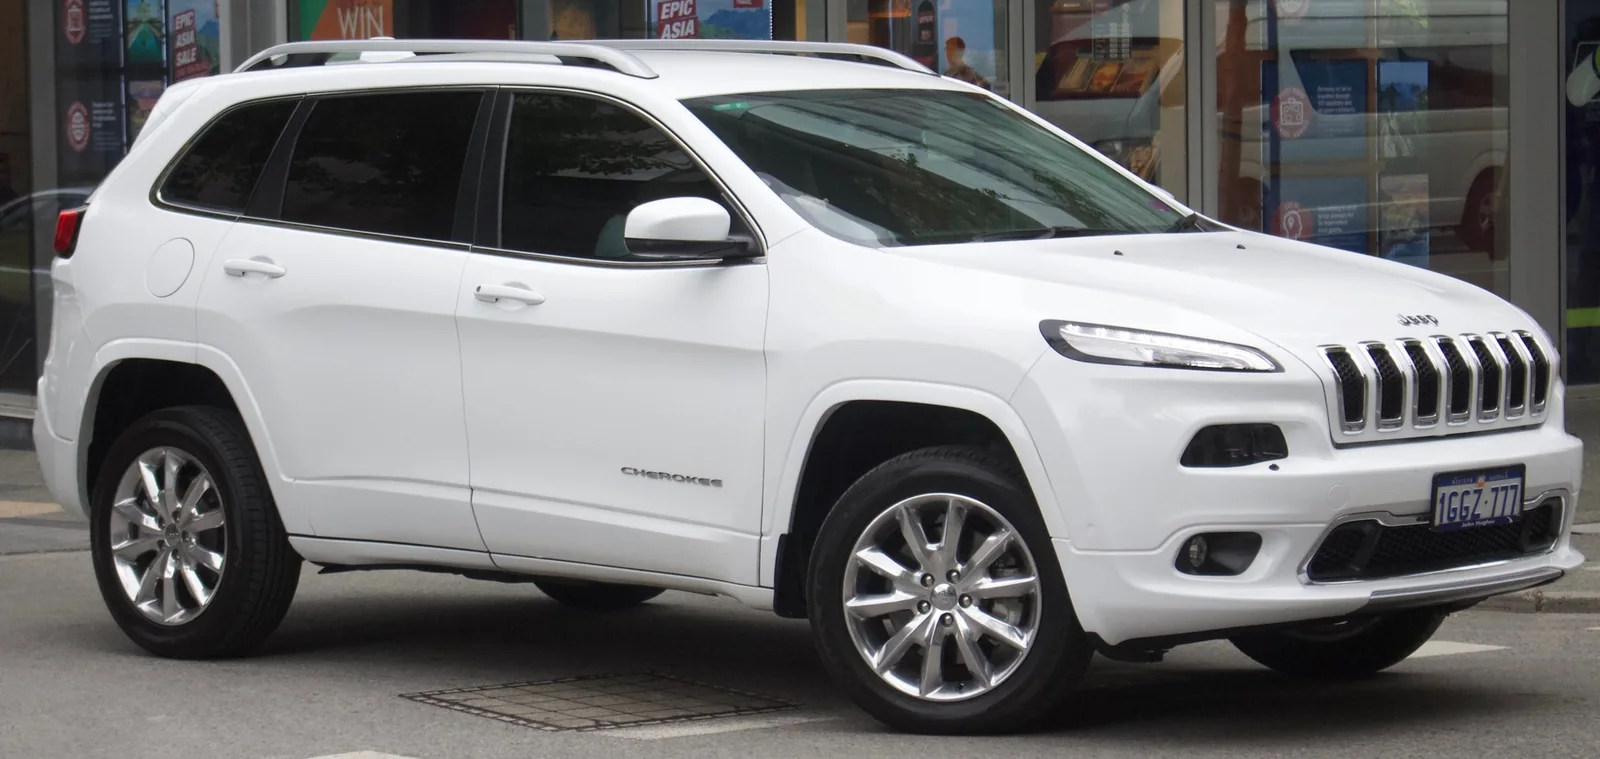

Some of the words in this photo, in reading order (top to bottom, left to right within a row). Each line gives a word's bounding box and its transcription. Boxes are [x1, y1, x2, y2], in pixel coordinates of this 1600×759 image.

[661, 0, 693, 19] EPIC
[176, 11, 194, 30] EPIC
[337, 5, 384, 39] WIN
[661, 19, 695, 39] ASIA
[175, 30, 195, 48] ASIA
[176, 48, 197, 66] SALE
[1396, 313, 1439, 327] Jeep
[620, 466, 723, 488] CHEROKEE
